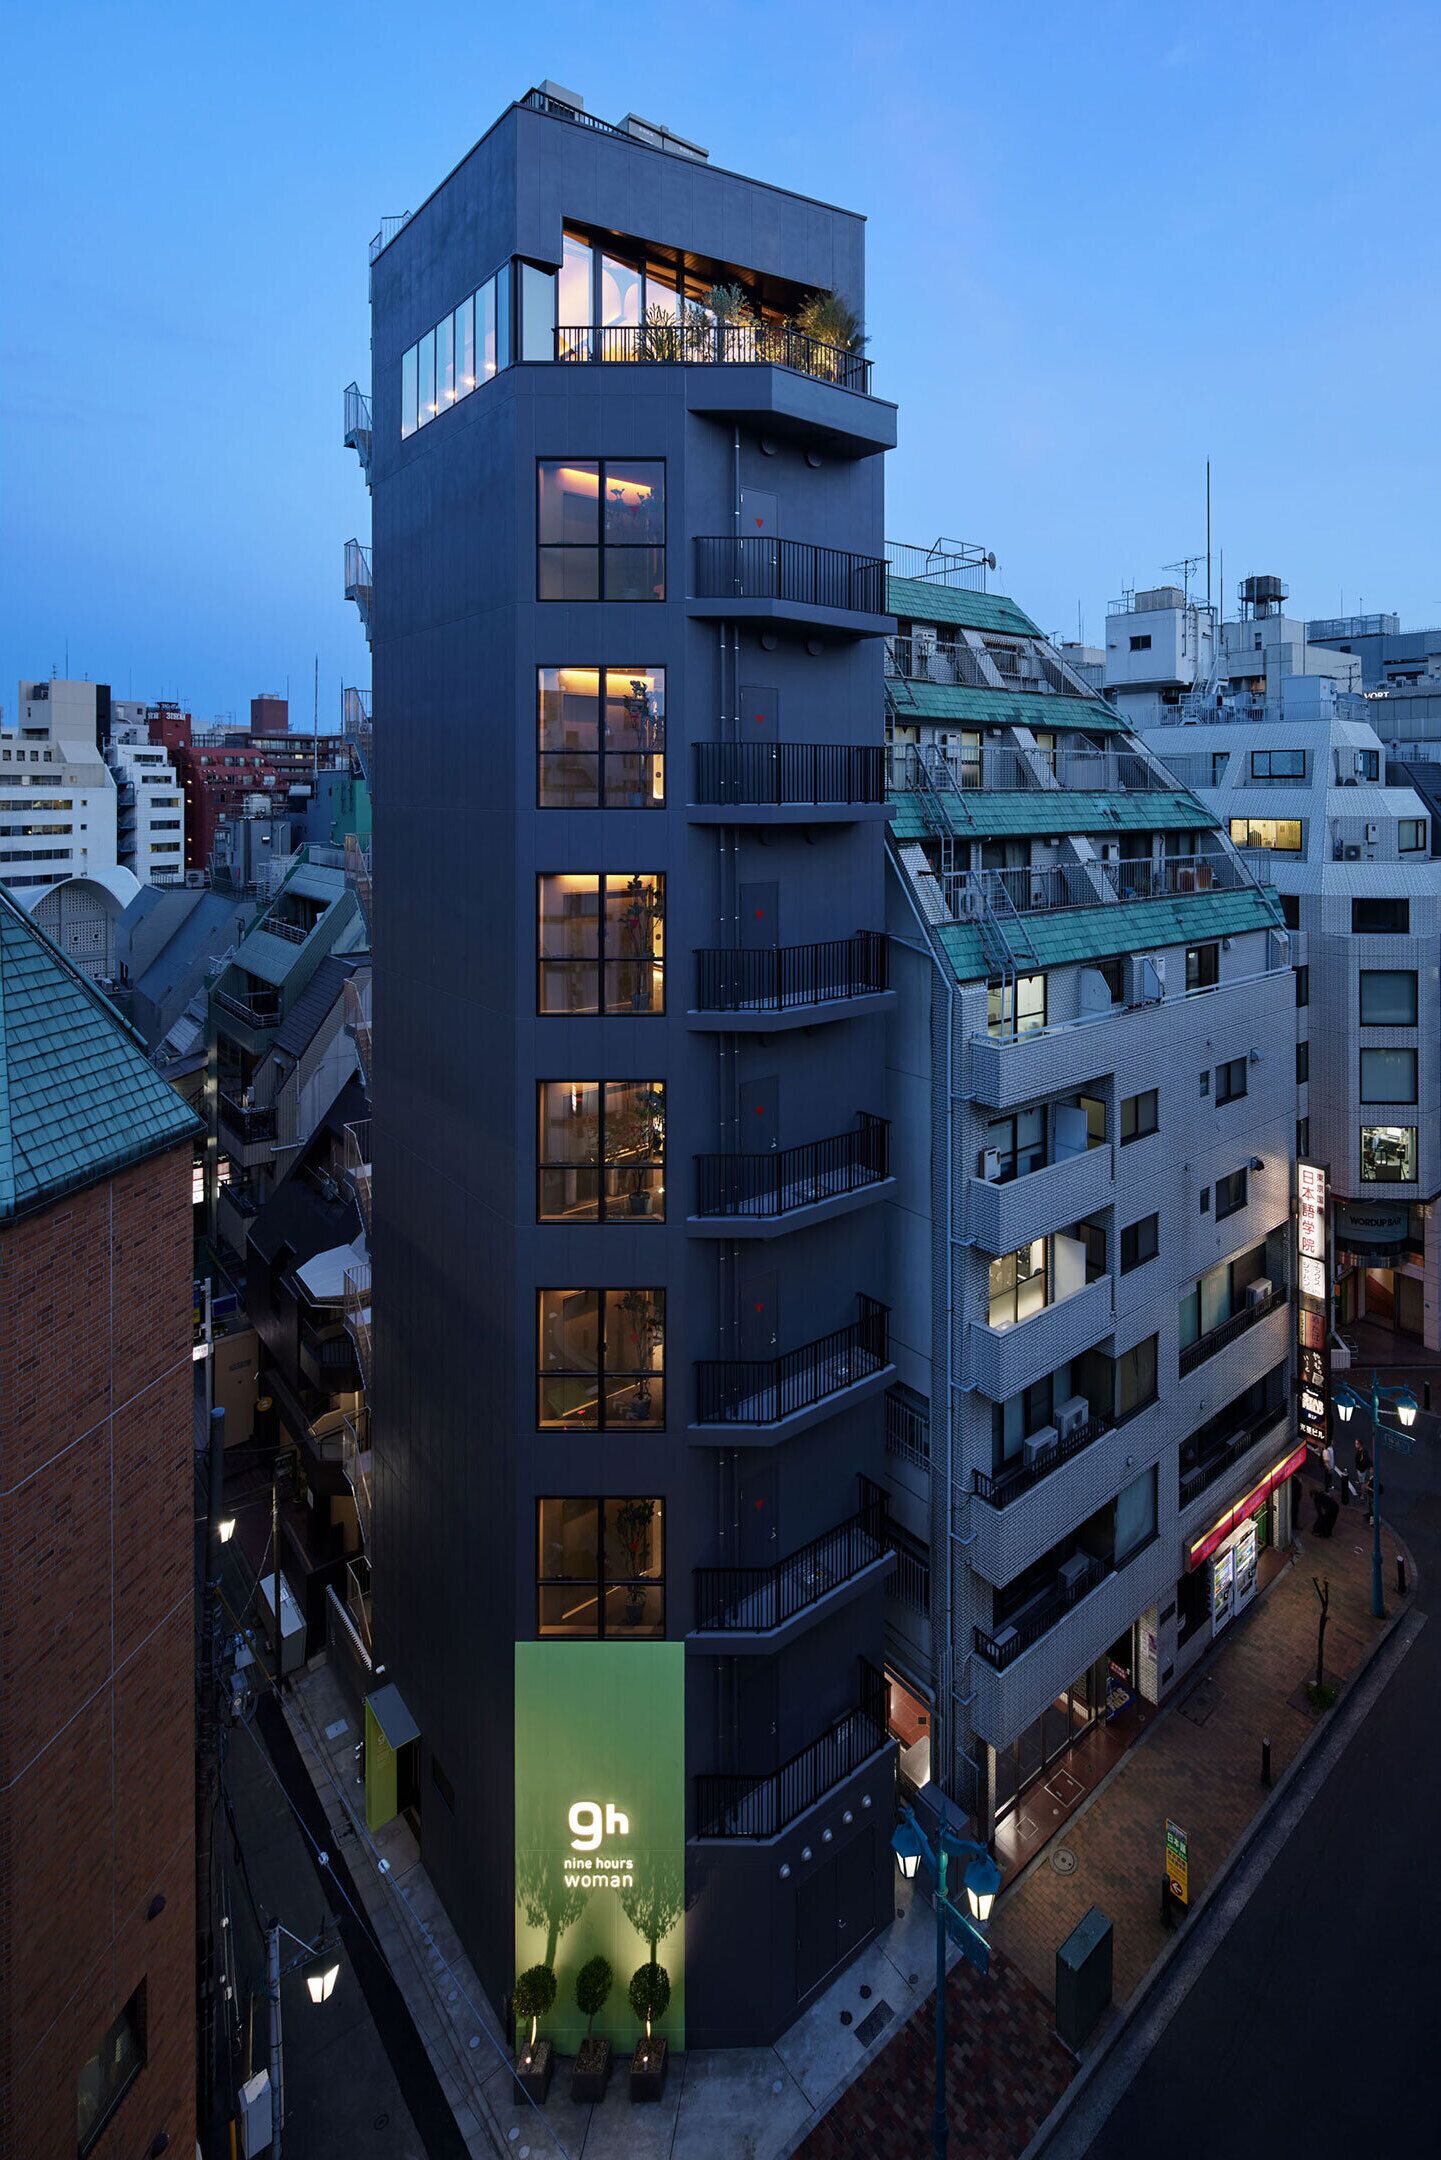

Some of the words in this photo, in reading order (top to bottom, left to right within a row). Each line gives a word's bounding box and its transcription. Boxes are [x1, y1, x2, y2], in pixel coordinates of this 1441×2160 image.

[1302, 1169, 1315, 1254] 日本語学院
[568, 1802, 629, 1851] 9h
[564, 1857, 592, 1869] nine
[595, 1857, 633, 1869] hours
[564, 1875, 633, 1888] woman
